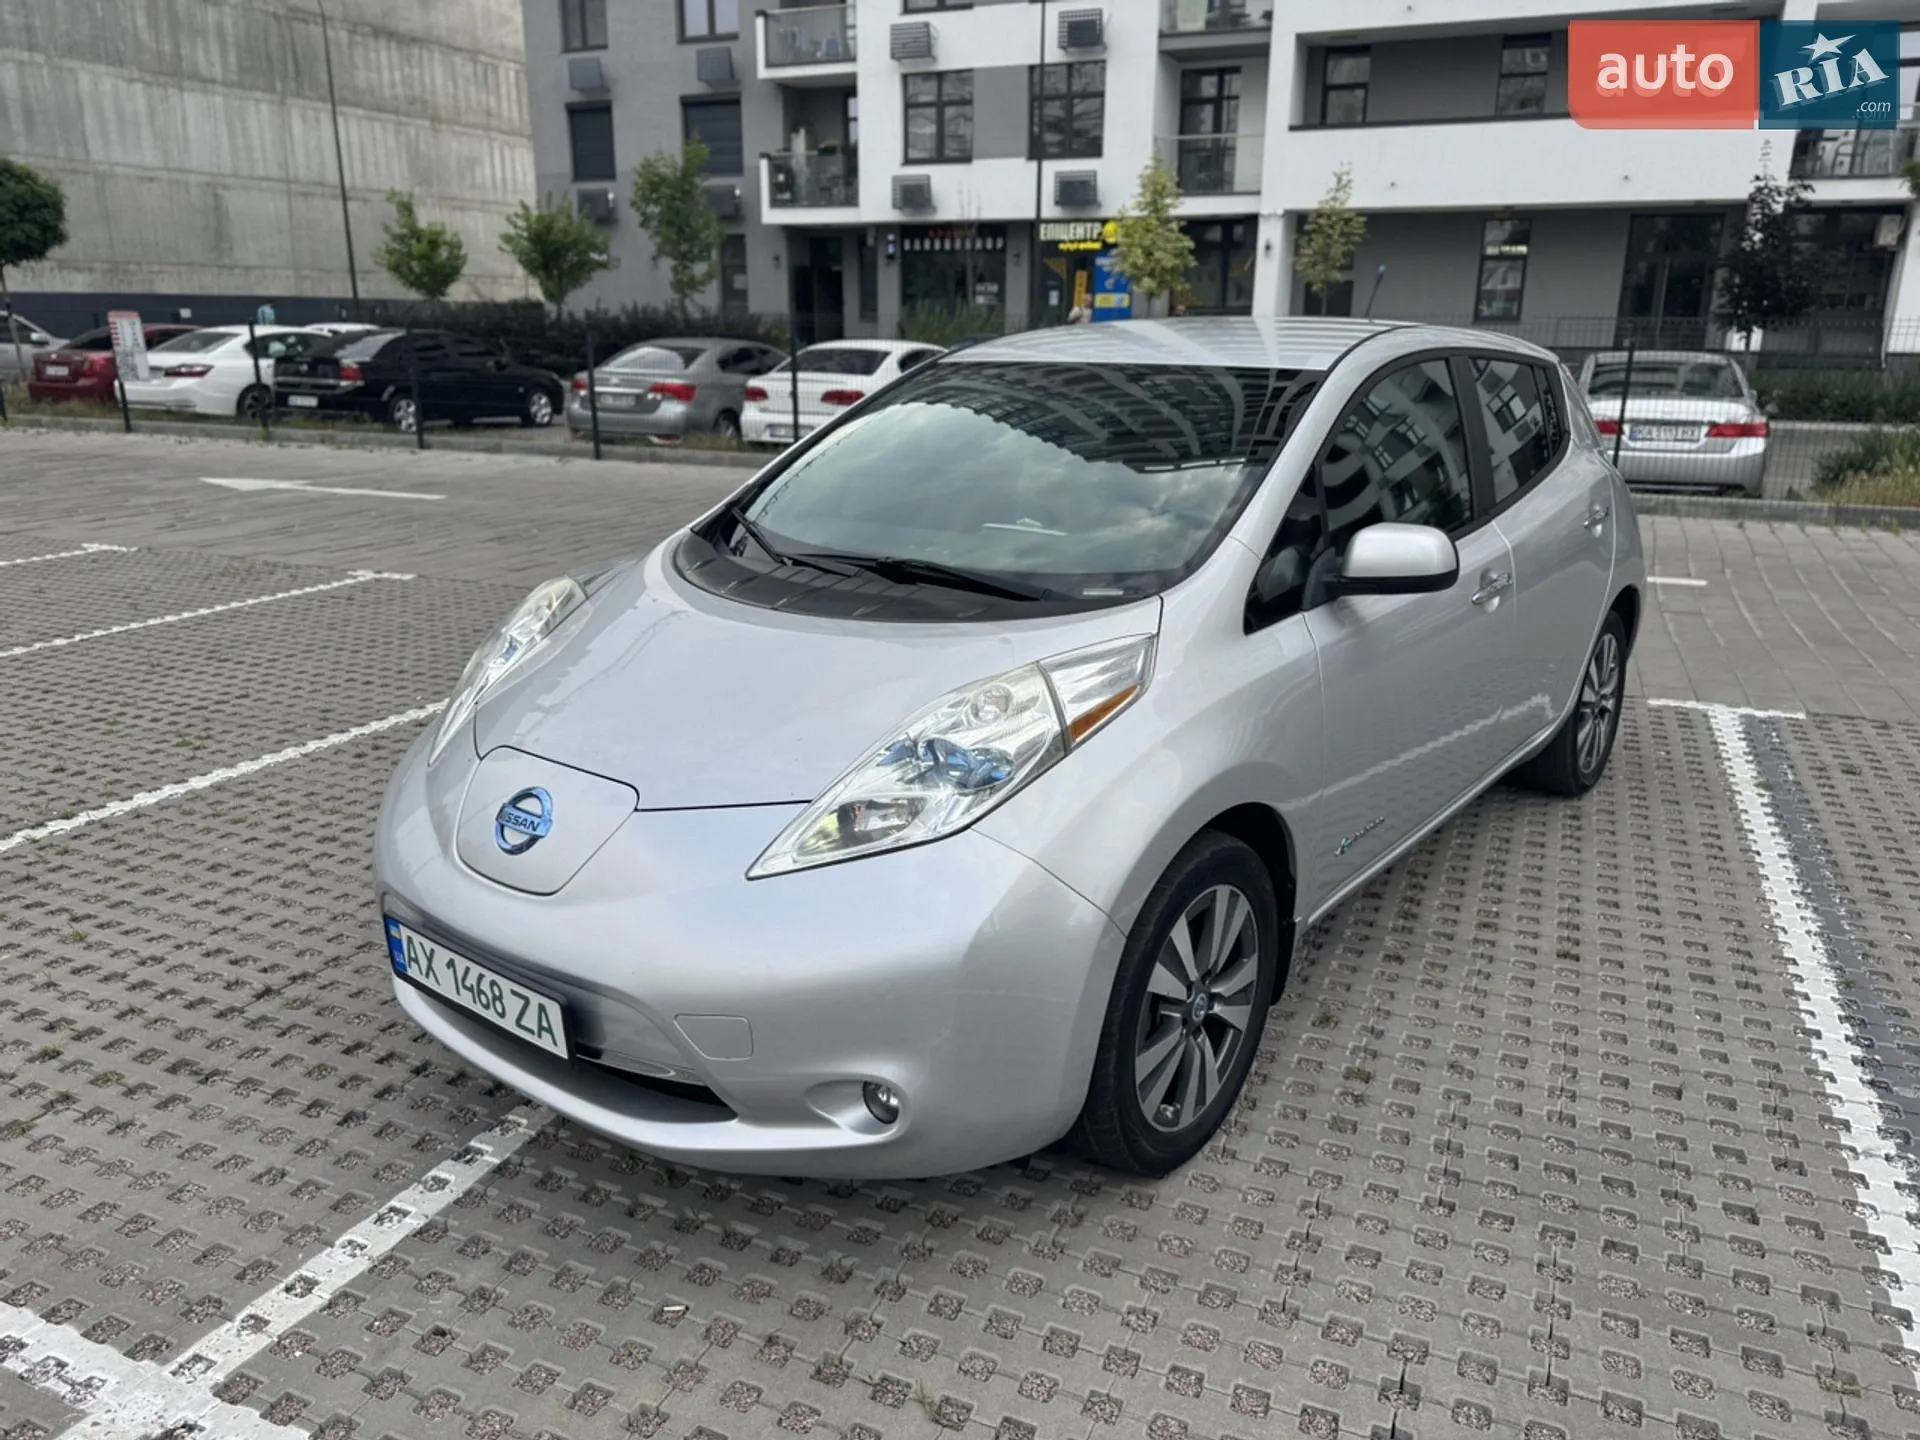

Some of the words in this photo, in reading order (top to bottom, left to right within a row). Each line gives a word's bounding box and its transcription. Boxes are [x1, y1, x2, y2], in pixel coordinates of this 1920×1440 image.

[406, 934, 441, 987] AX
[446, 957, 507, 1020] 1468
[510, 988, 558, 1048] ZA
